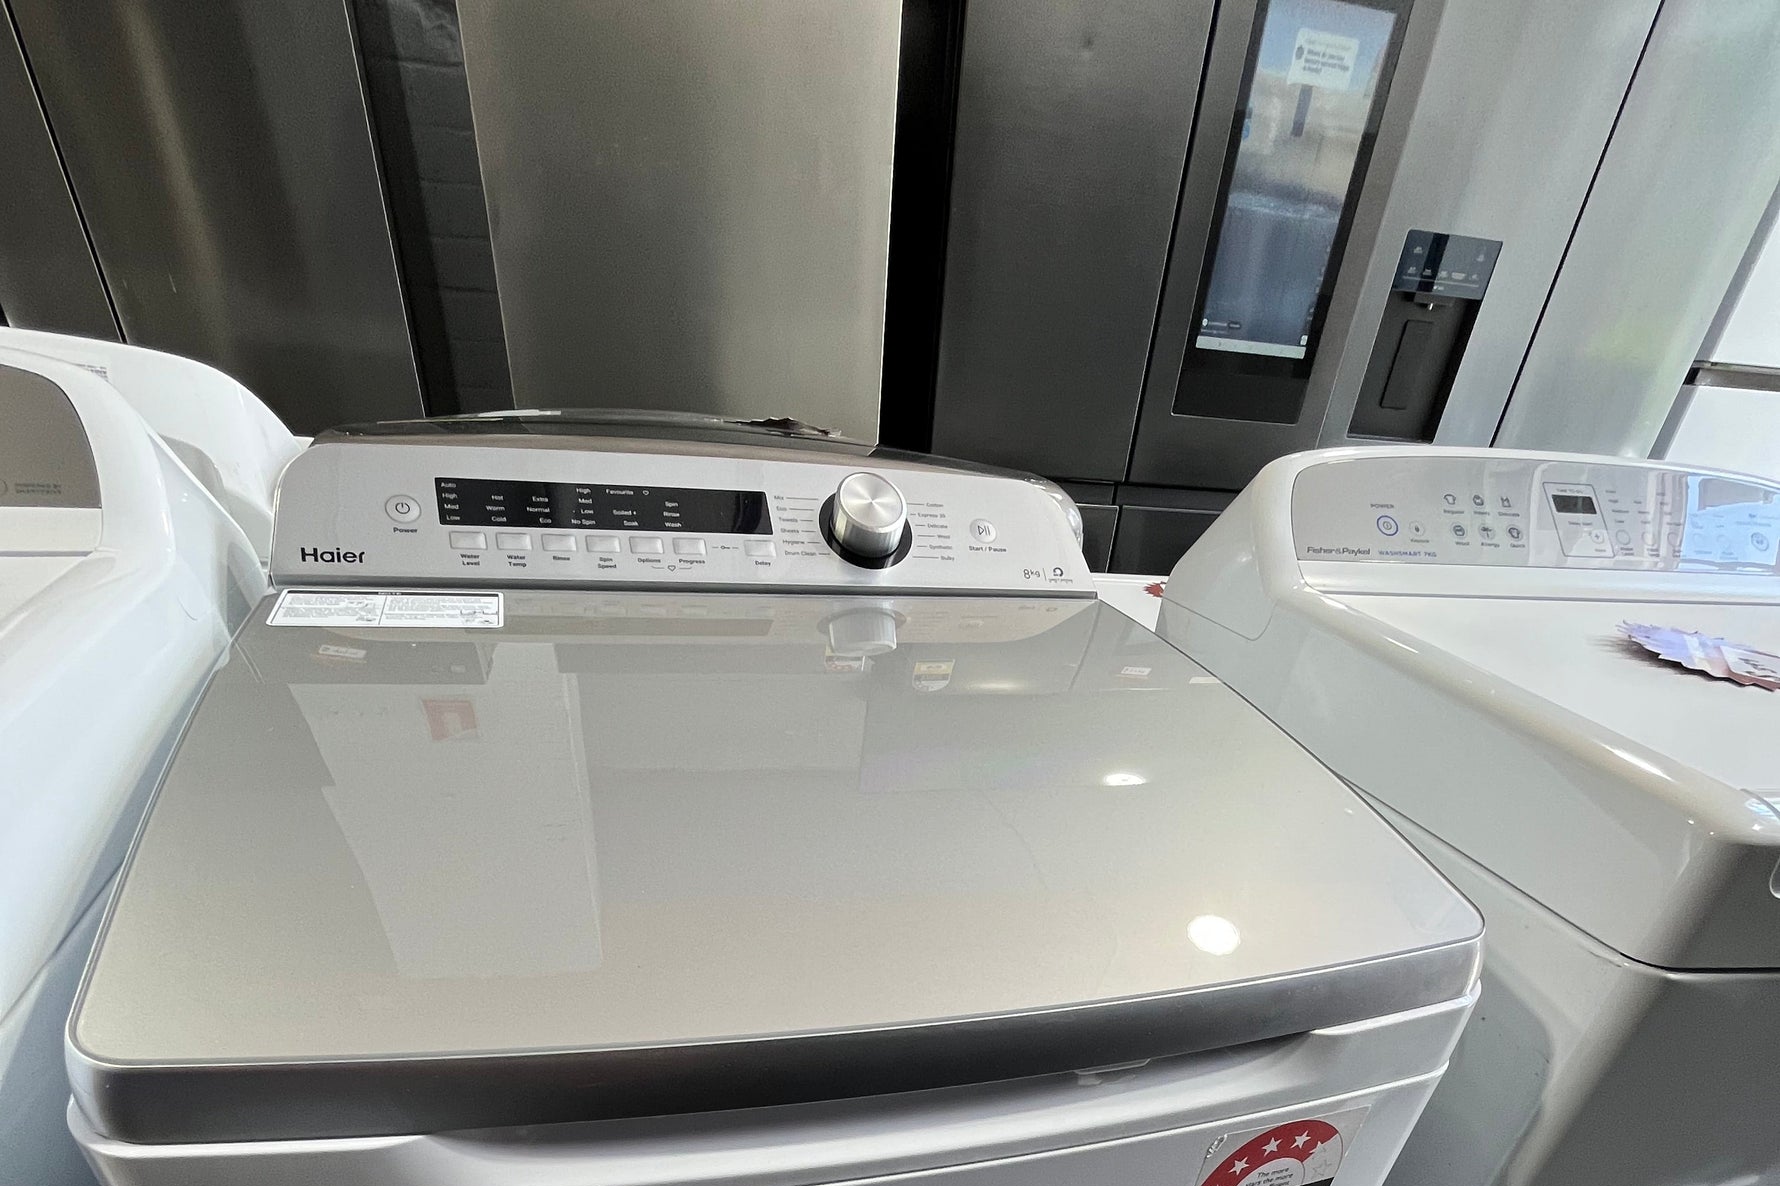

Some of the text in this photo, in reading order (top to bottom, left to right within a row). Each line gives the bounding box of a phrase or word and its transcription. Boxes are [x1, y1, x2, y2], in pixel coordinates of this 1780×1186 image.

[300, 547, 366, 564] Haier
[637, 557, 662, 565] Options
[678, 558, 706, 566] Progress
[1270, 1167, 1290, 1175] more
[1274, 1173, 1293, 1182] more
